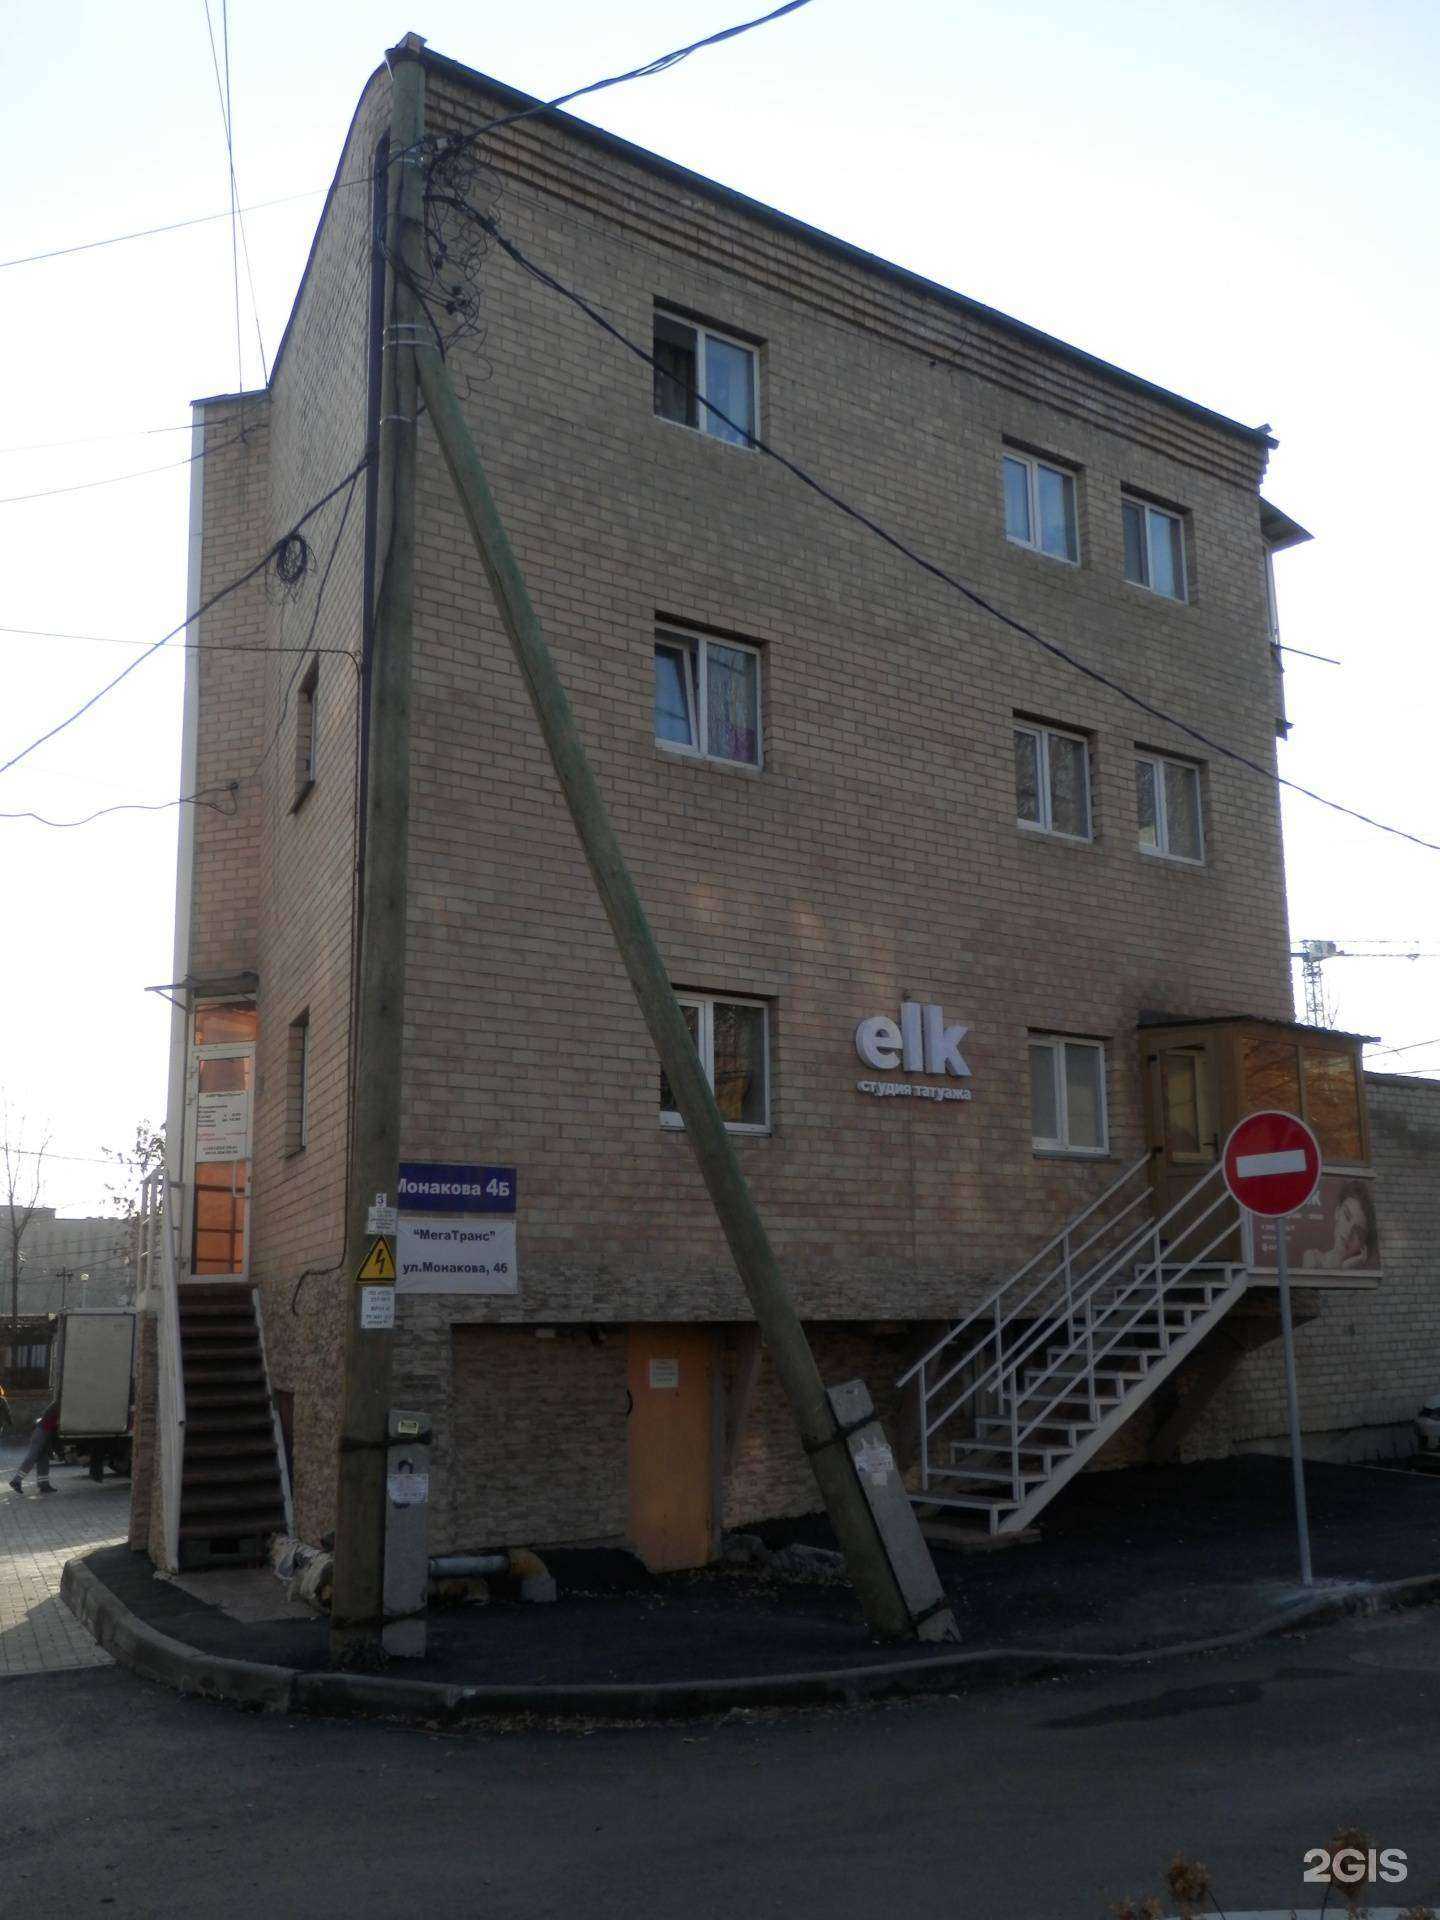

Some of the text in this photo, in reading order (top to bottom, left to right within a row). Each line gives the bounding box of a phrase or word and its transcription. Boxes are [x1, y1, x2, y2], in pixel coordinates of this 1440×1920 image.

[855, 1001, 972, 1078] elk
[857, 1080, 972, 1101] студия татуажа
